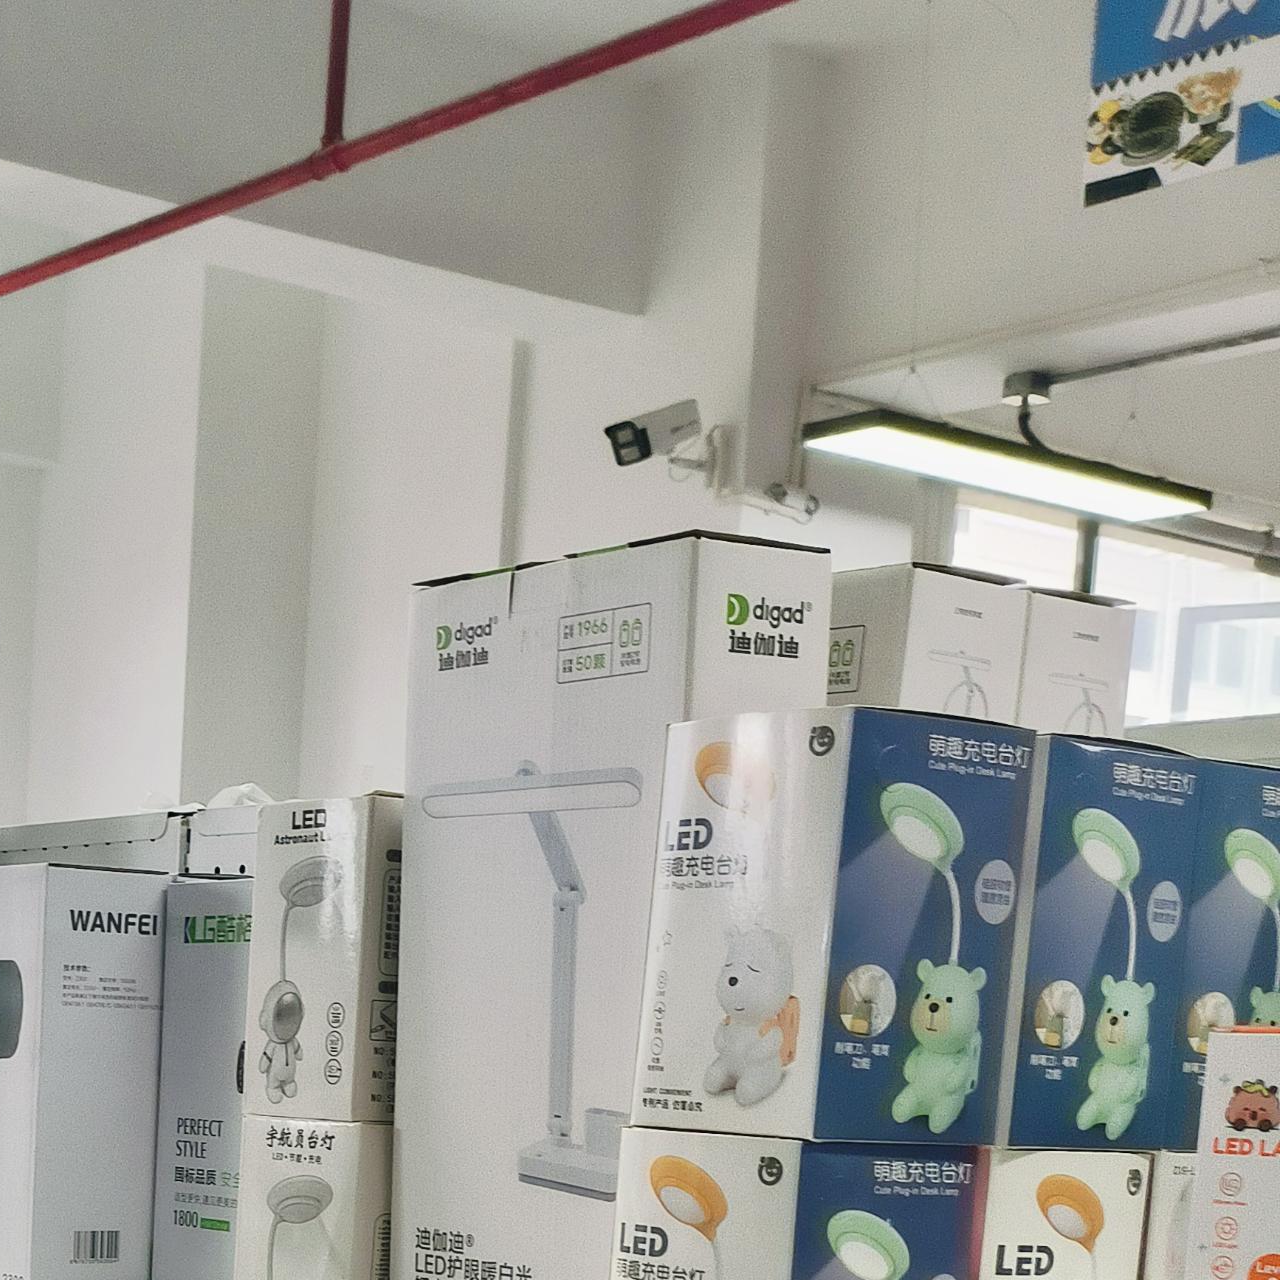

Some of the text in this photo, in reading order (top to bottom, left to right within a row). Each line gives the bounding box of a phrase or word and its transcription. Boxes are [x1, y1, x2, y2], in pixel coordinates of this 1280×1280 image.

[753, 599, 804, 628] digad
[454, 617, 493, 645] digad
[728, 629, 800, 659] 迪伽迪
[438, 647, 489, 672] 迪伽迪
[928, 734, 1032, 768] 萌趣充电台灯
[292, 808, 327, 830] LED
[274, 832, 319, 846] Astronaut
[69, 909, 158, 936] WANFEI
[176, 1117, 224, 1137] PERFECT
[175, 1139, 208, 1159] STYLE
[1212, 1137, 1254, 1156] LED
[174, 1166, 217, 1186] 国标品质
[873, 1160, 974, 1186] 萌趣充电台灯
[173, 1209, 198, 1228] 1800
[620, 1222, 668, 1257] LED
[995, 1244, 1054, 1276] LED
